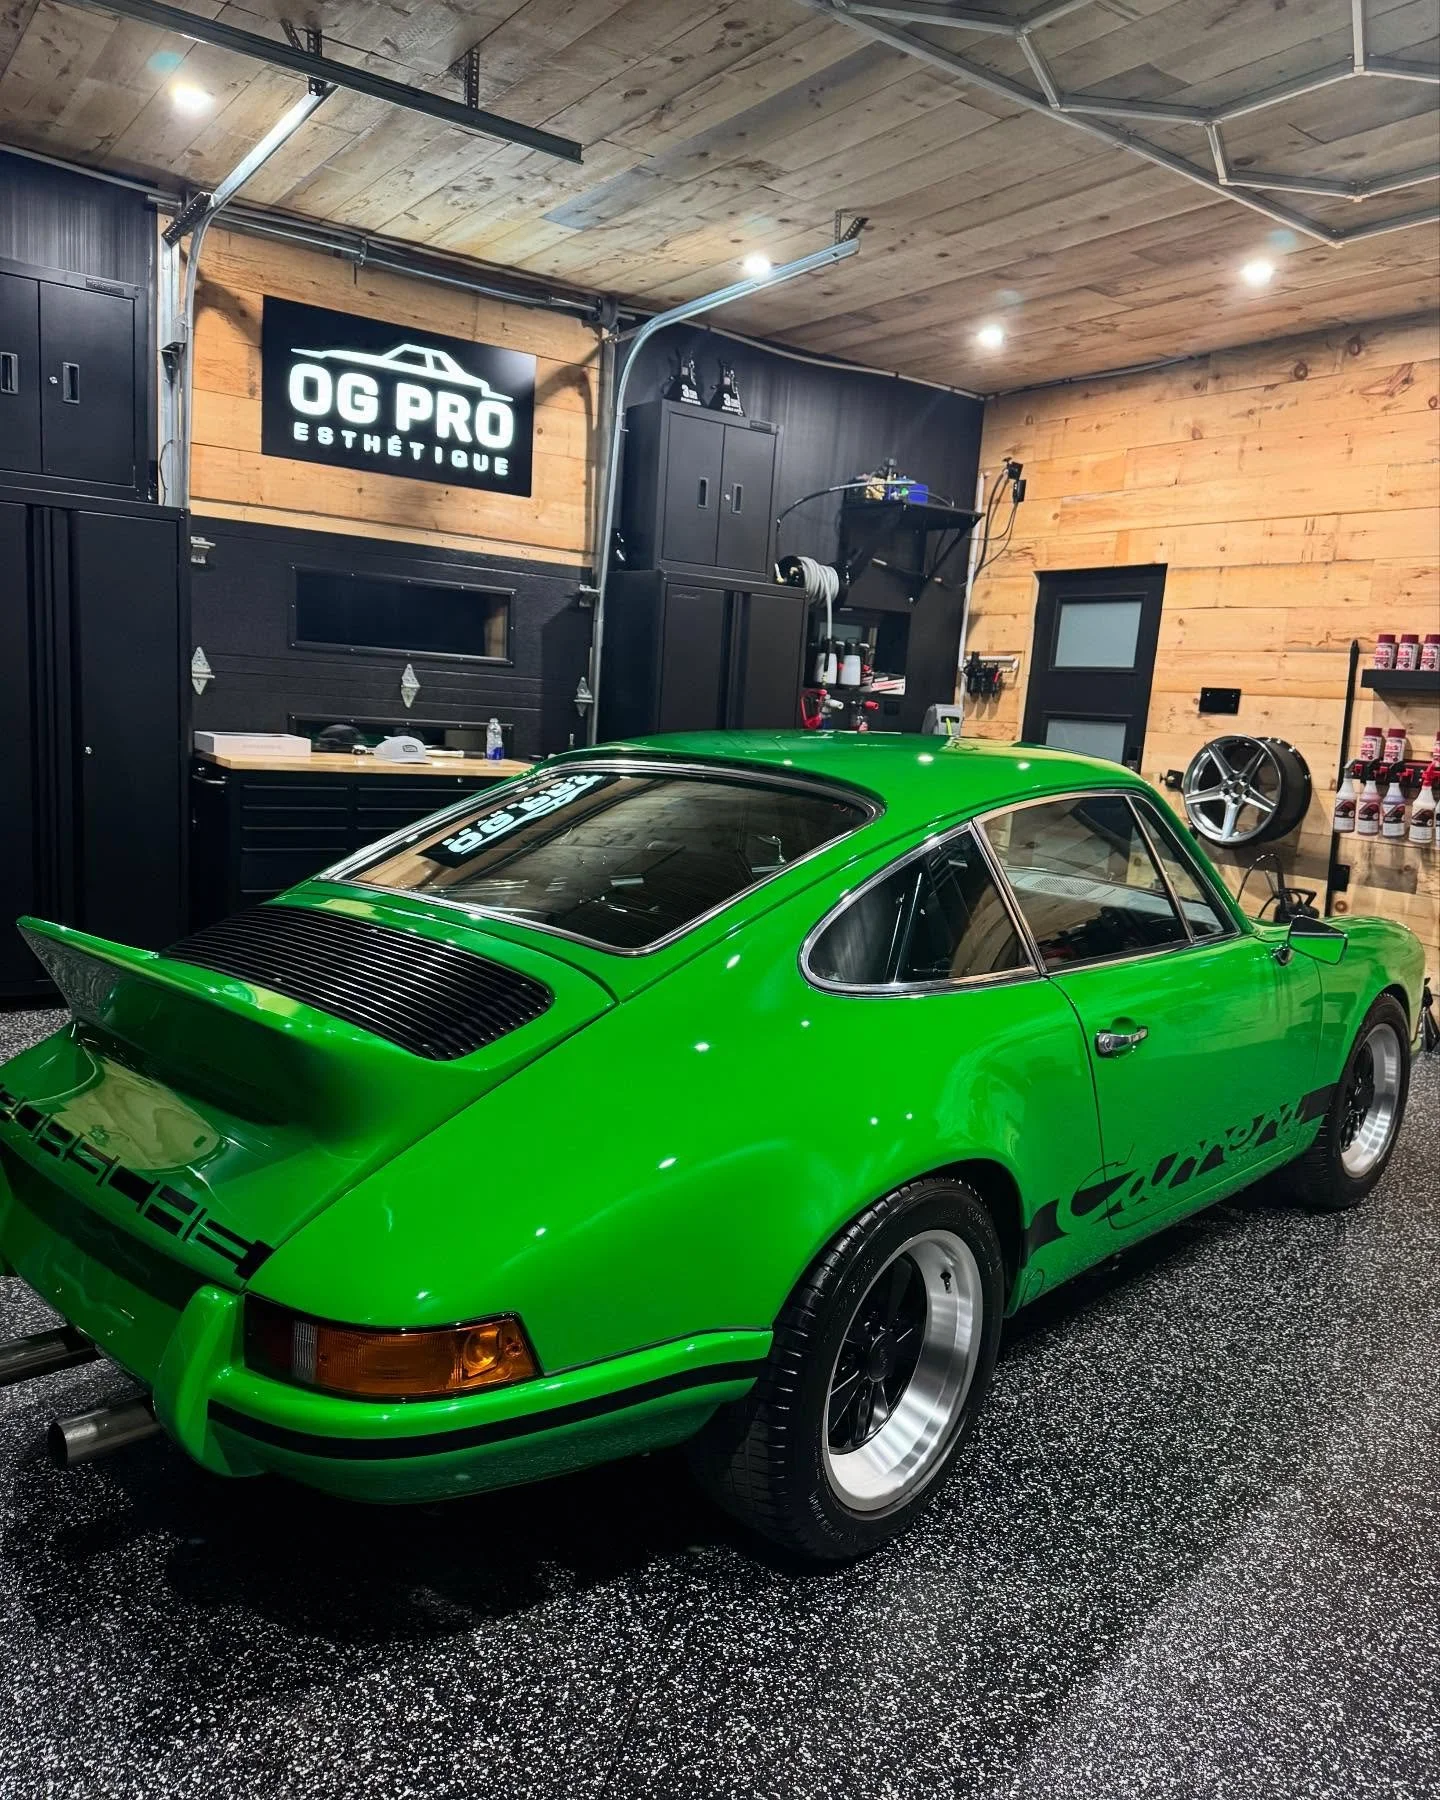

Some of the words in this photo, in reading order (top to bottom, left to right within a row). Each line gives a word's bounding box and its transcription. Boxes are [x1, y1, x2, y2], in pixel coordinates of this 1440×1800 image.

[288, 363, 379, 424] OG
[395, 381, 515, 450] PRO
[293, 421, 510, 476] ESTHÉTIQUE
[1056, 1098, 1304, 1233] Carrera
